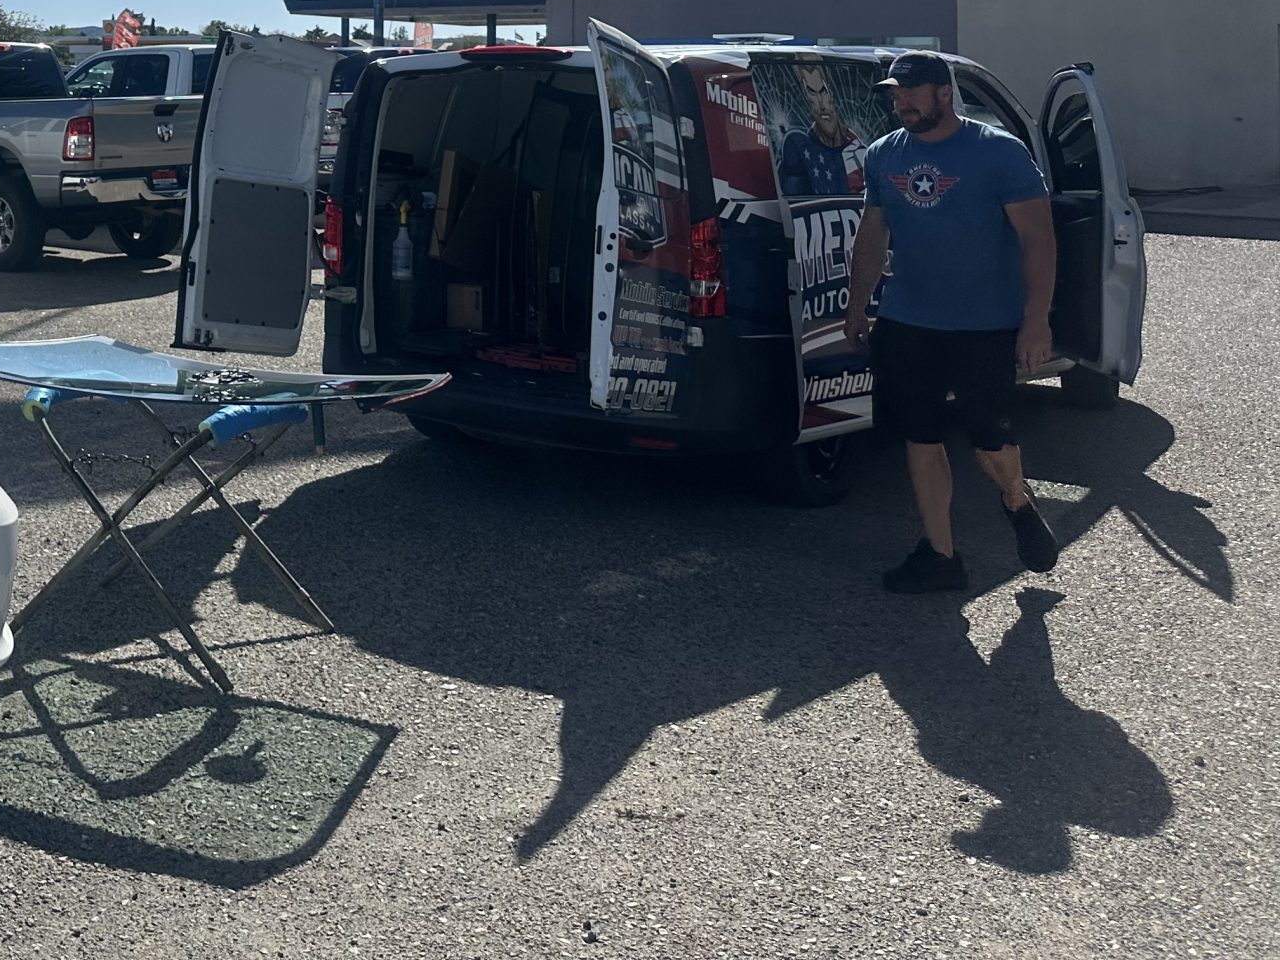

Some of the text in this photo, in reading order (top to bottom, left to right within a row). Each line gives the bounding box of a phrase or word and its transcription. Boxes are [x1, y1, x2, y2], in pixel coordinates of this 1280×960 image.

[706, 81, 758, 118] Mobile
[802, 287, 849, 321] AUTO
[606, 376, 677, 412] 20-0821
[803, 368, 873, 403] inshei
